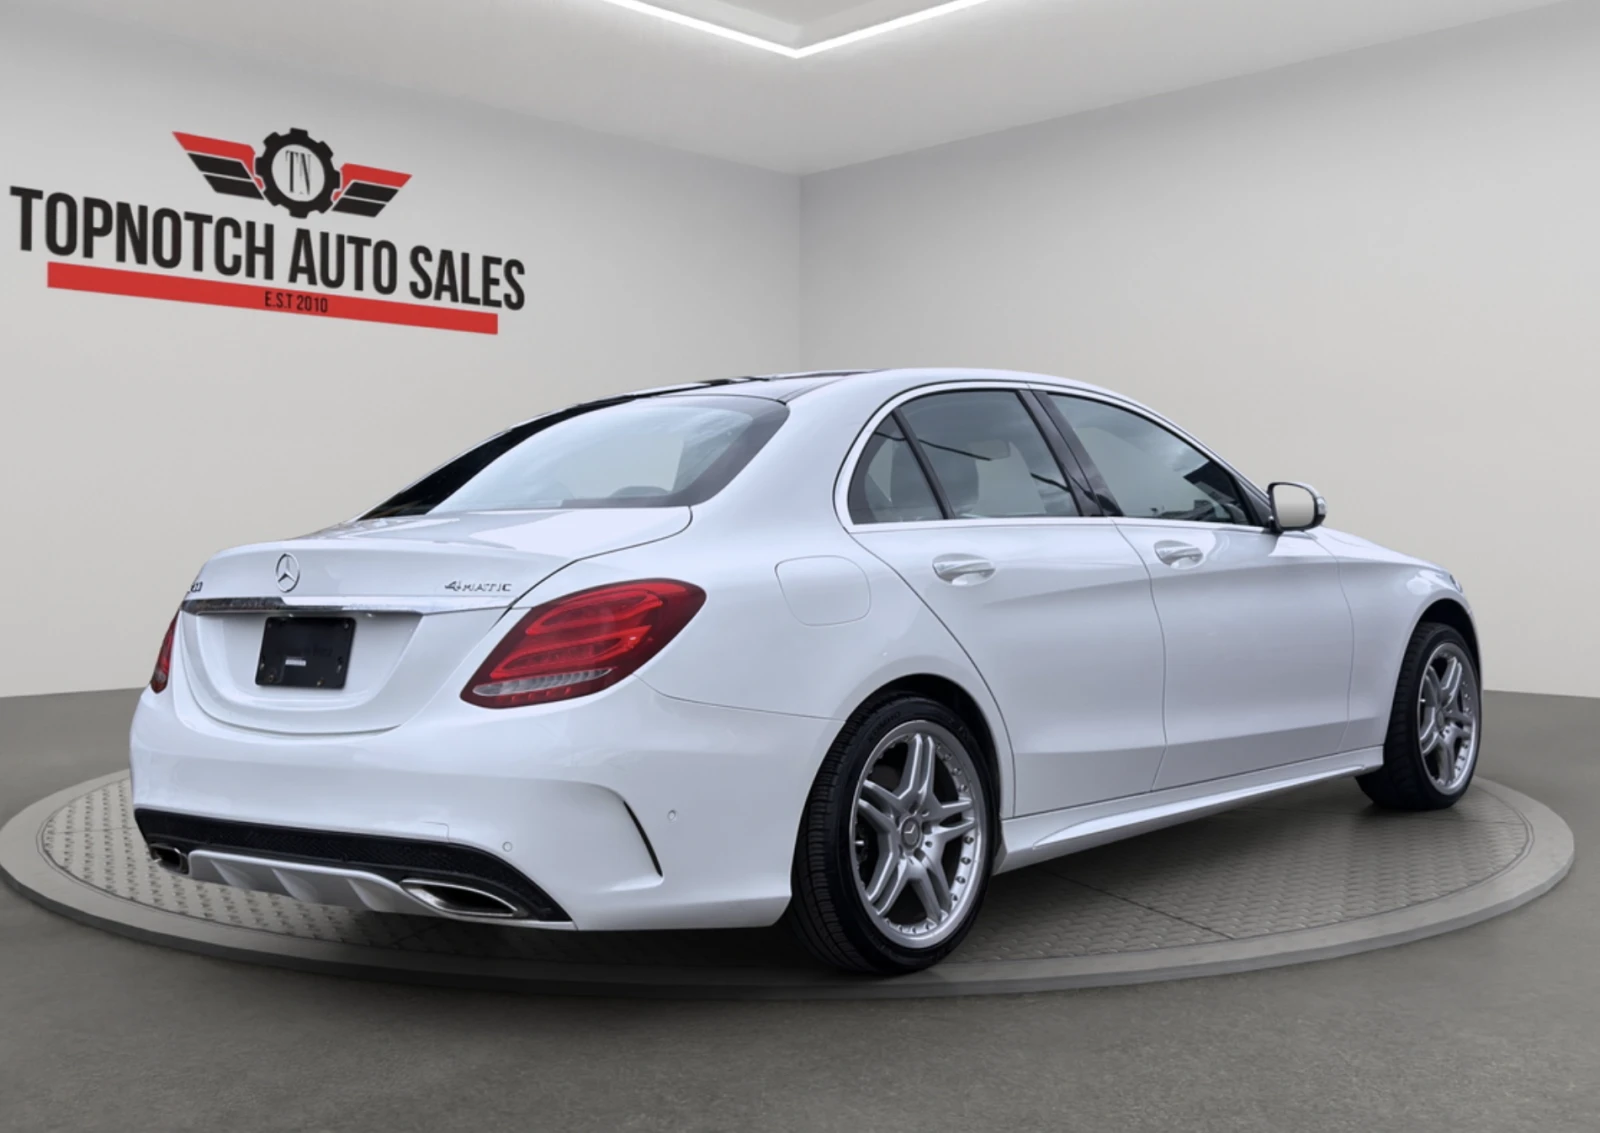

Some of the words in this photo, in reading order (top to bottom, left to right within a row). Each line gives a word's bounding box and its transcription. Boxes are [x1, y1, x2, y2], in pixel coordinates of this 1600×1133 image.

[285, 150, 311, 195] TN
[10, 185, 274, 281] TOPNOTCH
[288, 227, 398, 295] AUTO
[409, 245, 525, 311] SALES
[296, 294, 329, 314] 2010
